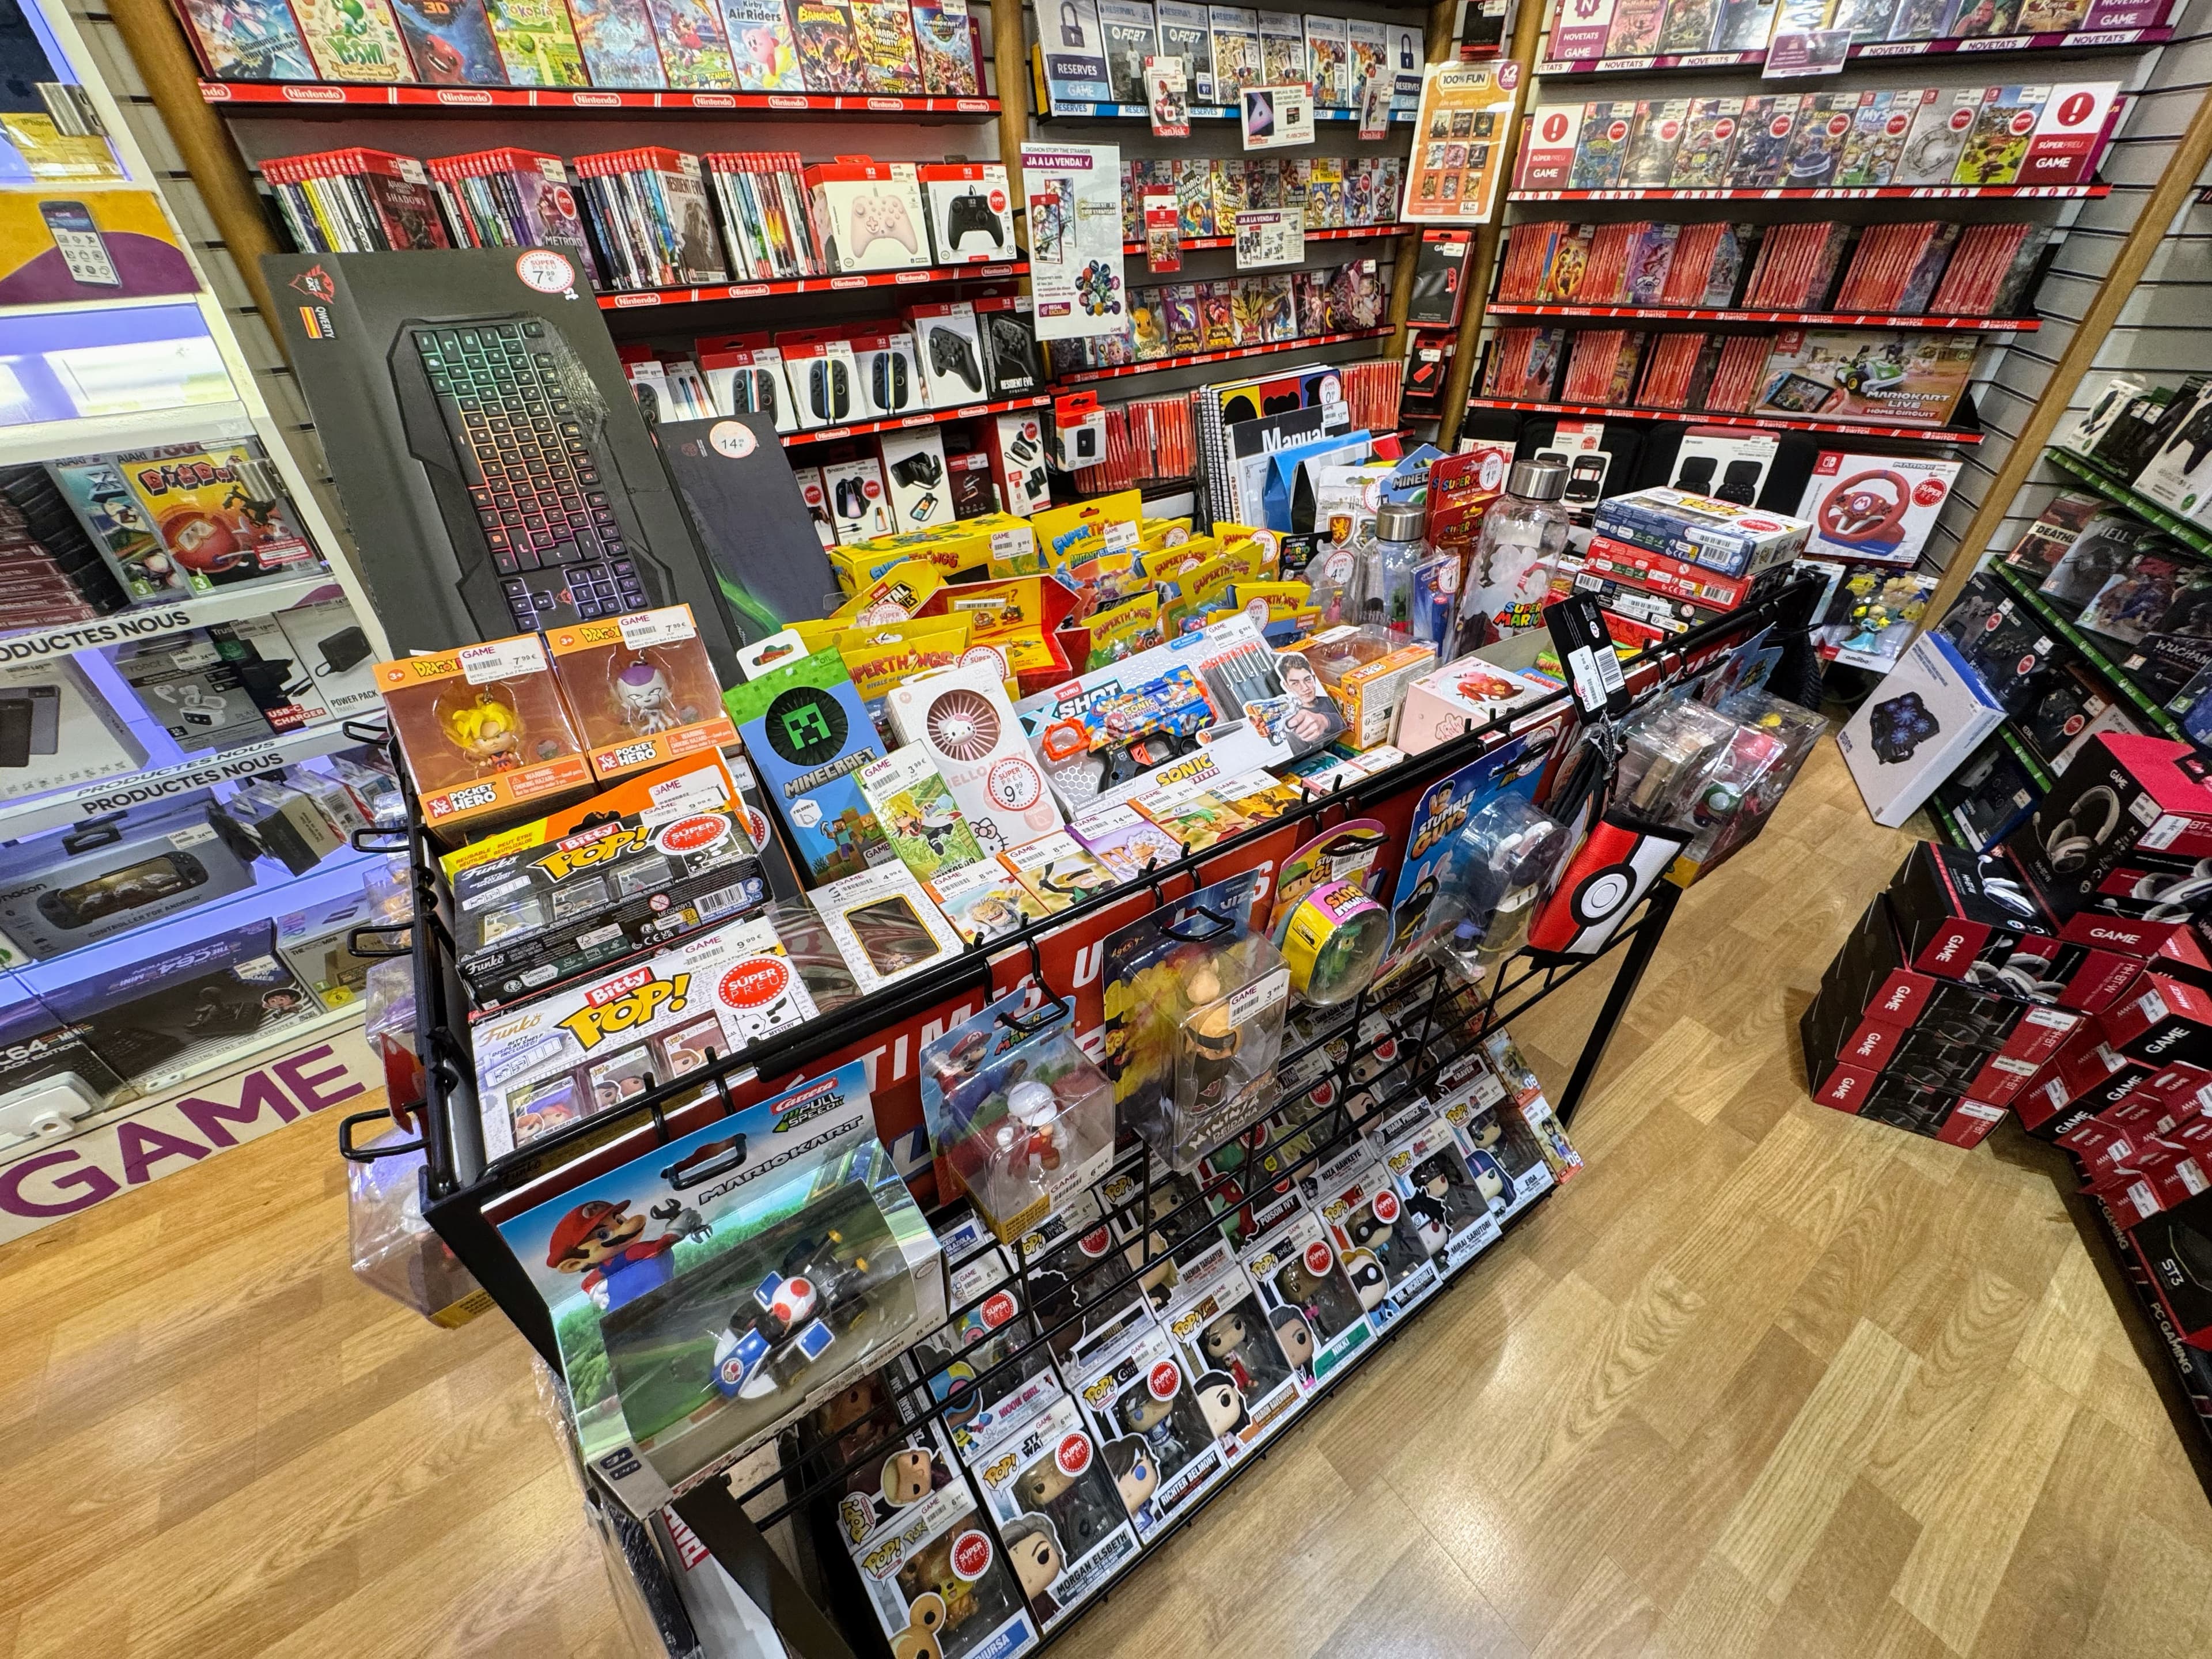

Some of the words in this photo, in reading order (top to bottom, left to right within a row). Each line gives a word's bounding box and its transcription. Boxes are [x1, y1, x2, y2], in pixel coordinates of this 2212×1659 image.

[1563, 32, 1599, 40] NOVETATS
[2073, 33, 2126, 44] NOVETATS
[1869, 46, 1915, 55] NOVETATS
[1968, 40, 2018, 50] NOVETATS
[1565, 47, 1590, 57] GAME
[1604, 60, 1643, 69] NOVETATS
[1688, 55, 1729, 65] NOVETATS
[1058, 64, 1097, 75] RESERVES
[1466, 73, 1485, 83] FUN
[289, 88, 341, 100] Nintendo
[442, 92, 488, 103] Nintendo
[578, 96, 617, 104] Nintendo
[696, 97, 732, 106] Nintendo
[772, 99, 805, 107] Nintendo
[2036, 157, 2071, 169] GAME
[1533, 168, 1558, 178] GAME
[984, 267, 1011, 275] Nintendo
[899, 272, 927, 282] Nintendo
[834, 279, 864, 288] Nintendo
[732, 286, 767, 296] Nintendo
[618, 295, 657, 306] Nintendo
[961, 407, 986, 416] Nintendo
[905, 415, 933, 425] Nintendo
[817, 429, 848, 440] Nintendo
[121, 610, 191, 637] NOUS
[462, 646, 495, 658] GAME
[615, 741, 656, 756] POCKET
[618, 748, 658, 767] HERO
[81, 770, 221, 815] PRODUCTES
[222, 752, 285, 782] NOUS
[449, 783, 494, 801] POCKET
[452, 790, 497, 812] HERO
[671, 821, 715, 841] SÚPER
[566, 824, 615, 850] Bitty
[2090, 927, 2141, 945] GAME
[685, 935, 721, 955] GAME
[1940, 934, 1965, 964] GAME
[728, 968, 778, 991] SÚPER
[591, 969, 647, 1004] Bitty
[1885, 985, 1911, 1012] GAME
[560, 974, 692, 1049] POP!
[1857, 1032, 1881, 1058] GAME
[2145, 1027, 2190, 1054] GAME
[1832, 1077, 1856, 1101] GAME
[0, 1045, 367, 1218] GAME
